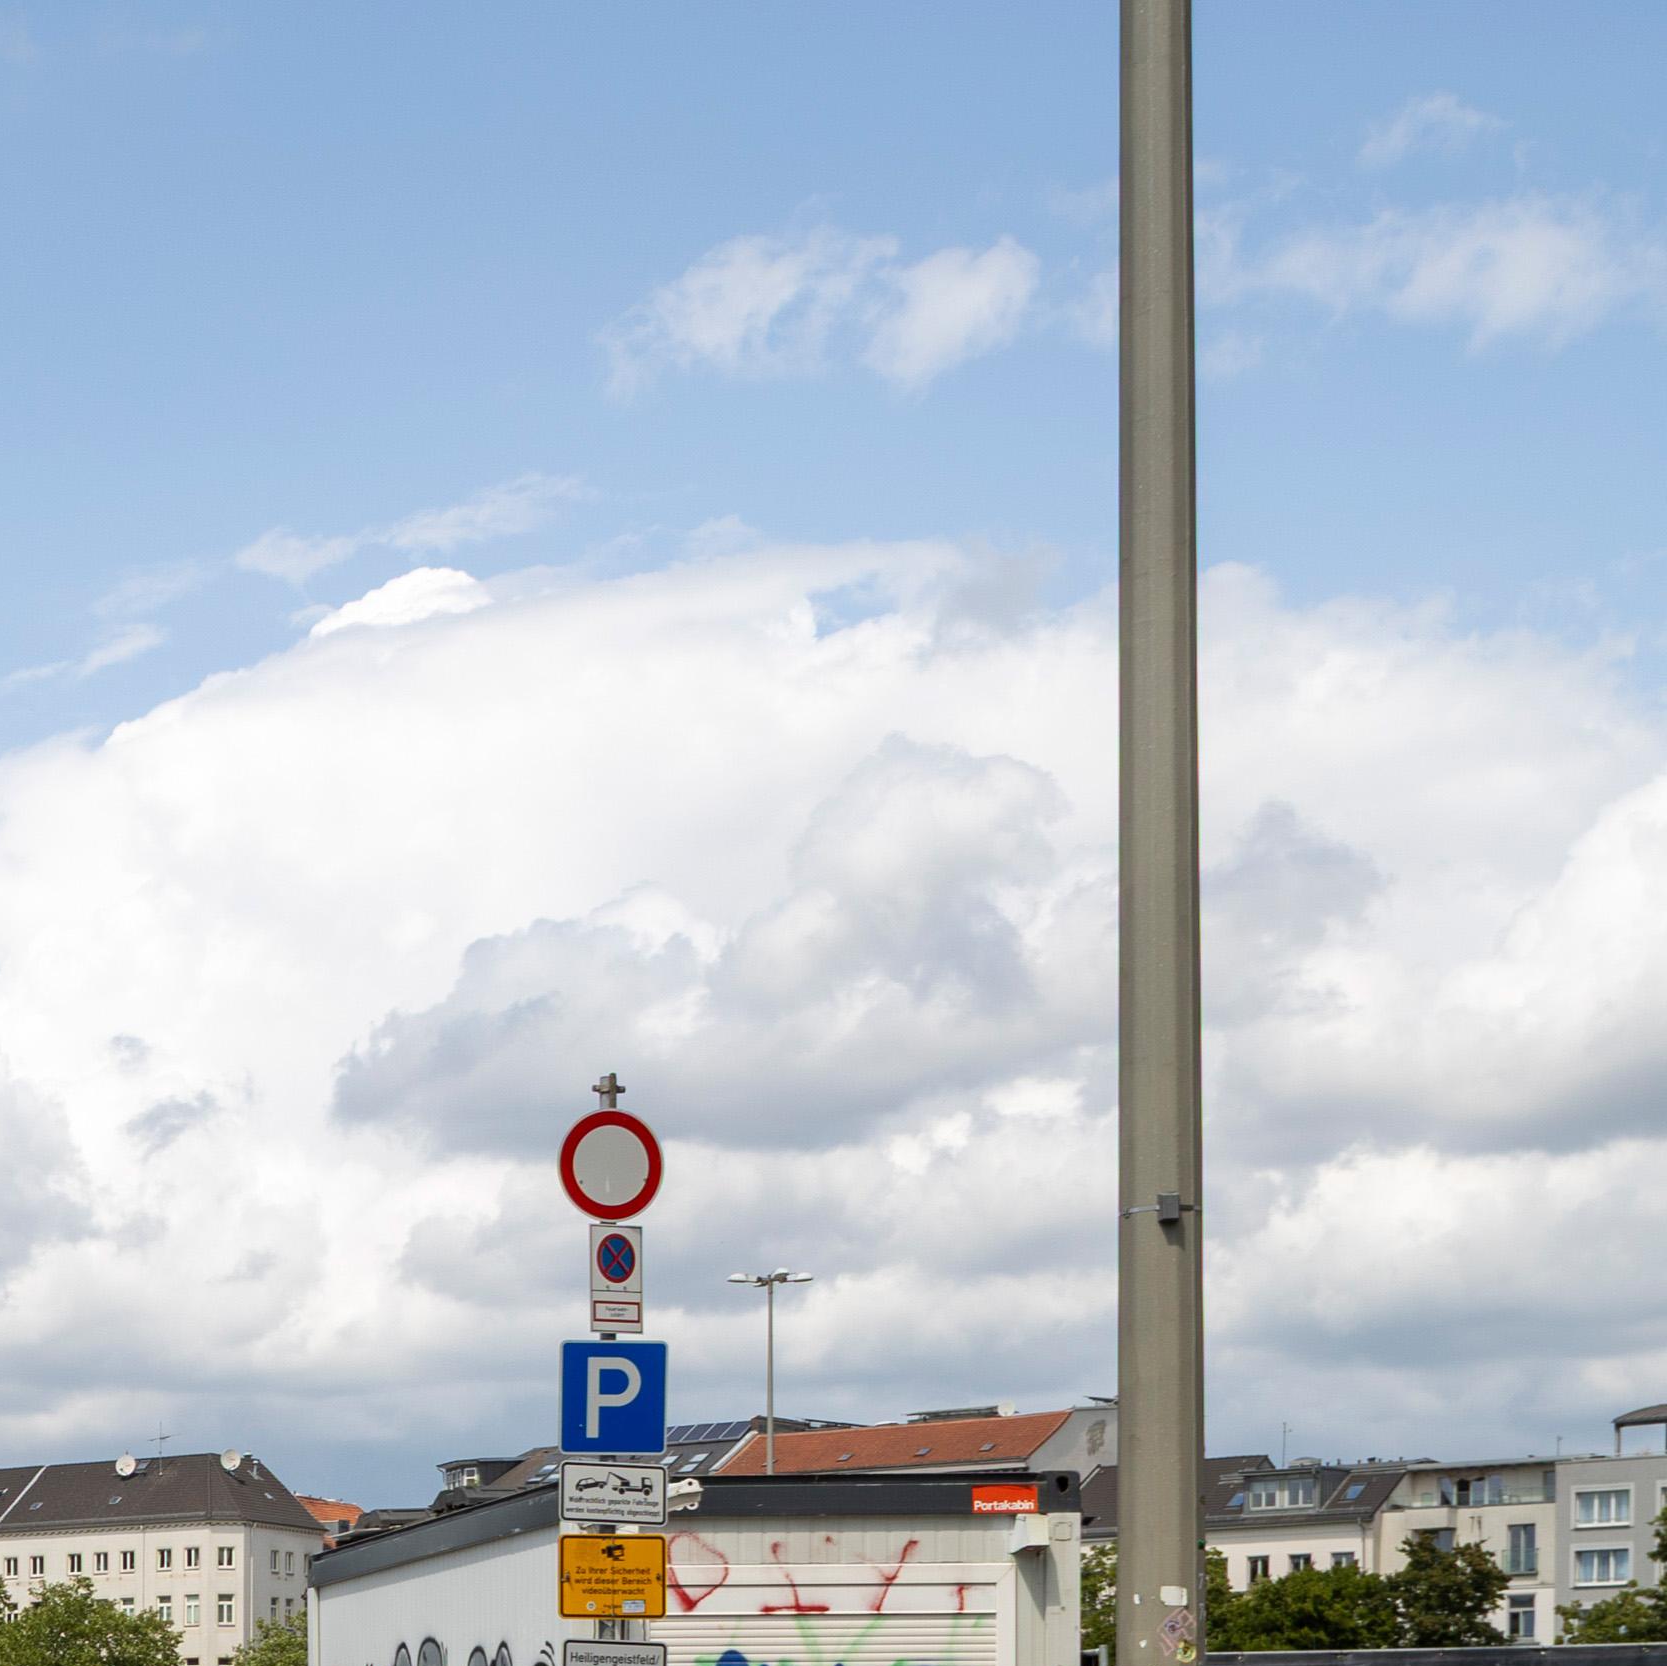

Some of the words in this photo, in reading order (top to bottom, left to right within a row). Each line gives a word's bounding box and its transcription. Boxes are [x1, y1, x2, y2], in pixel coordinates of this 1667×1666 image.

[586, 1357, 641, 1438] P
[974, 1500, 1034, 1511] Portakabin
[575, 1567, 586, 1575] Zu
[589, 1567, 608, 1575] Ihrer
[611, 1567, 651, 1576] Sicherheit
[595, 1576, 619, 1585] dieser
[622, 1577, 652, 1585] Bereich
[581, 1586, 645, 1595] videoüberwacht
[570, 1652, 660, 1666] Heiligengeistfeld/
